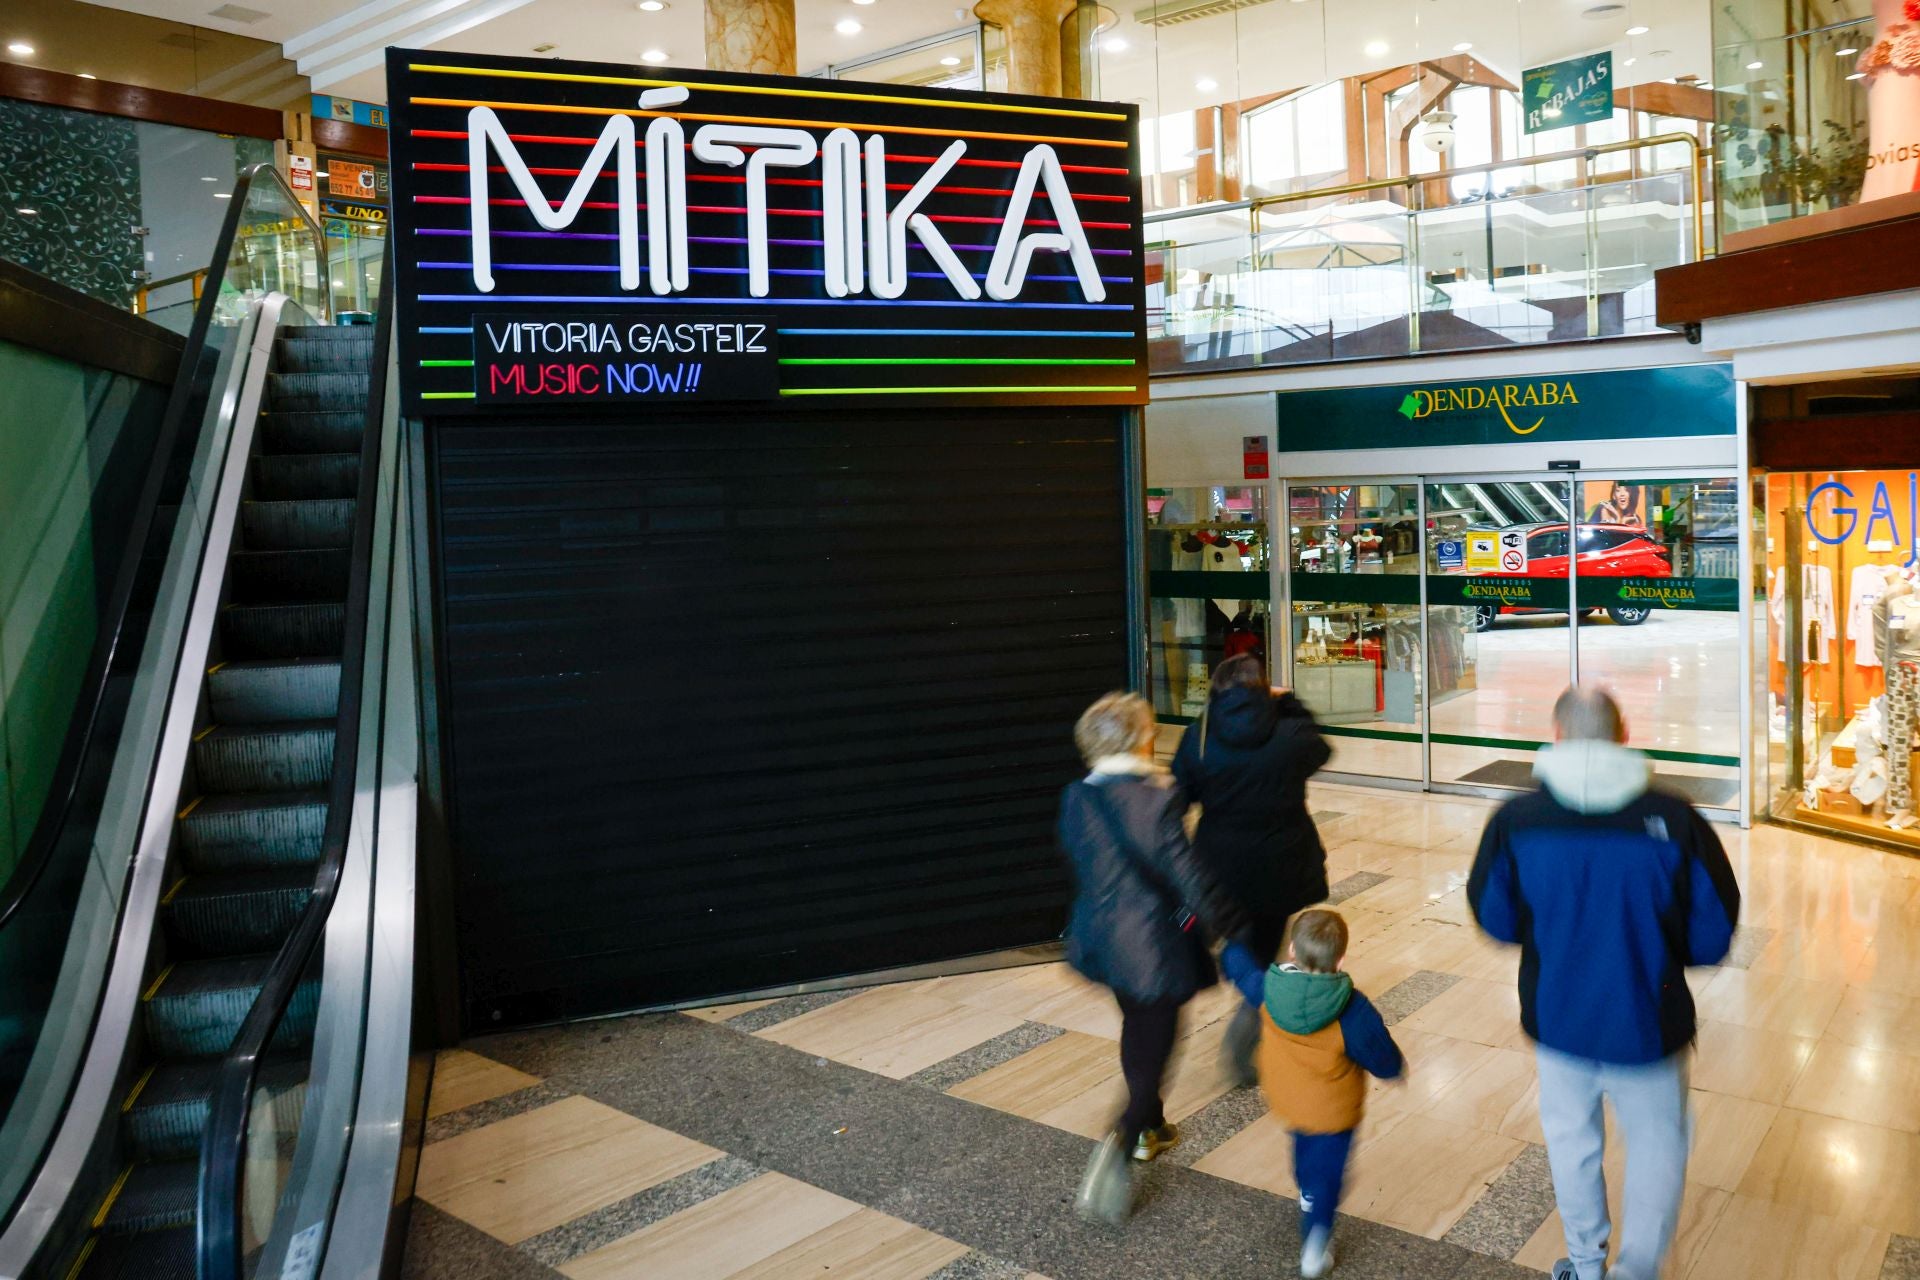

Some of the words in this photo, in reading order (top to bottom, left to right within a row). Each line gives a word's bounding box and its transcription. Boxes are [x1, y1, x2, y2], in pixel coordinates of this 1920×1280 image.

[1529, 60, 1608, 129] REBAJAS
[371, 110, 387, 127] EL
[467, 85, 1106, 303] MÍTIKA
[346, 206, 384, 220] UNO
[485, 322, 622, 353] VITORIA
[628, 323, 768, 353] GASTEIZ
[490, 363, 600, 395] MUSIC
[606, 363, 702, 394] NOW!!
[1412, 381, 1580, 434] DENDARABA
[1467, 585, 1531, 605] DENDARABA
[1623, 586, 1695, 608] DENDARABA
